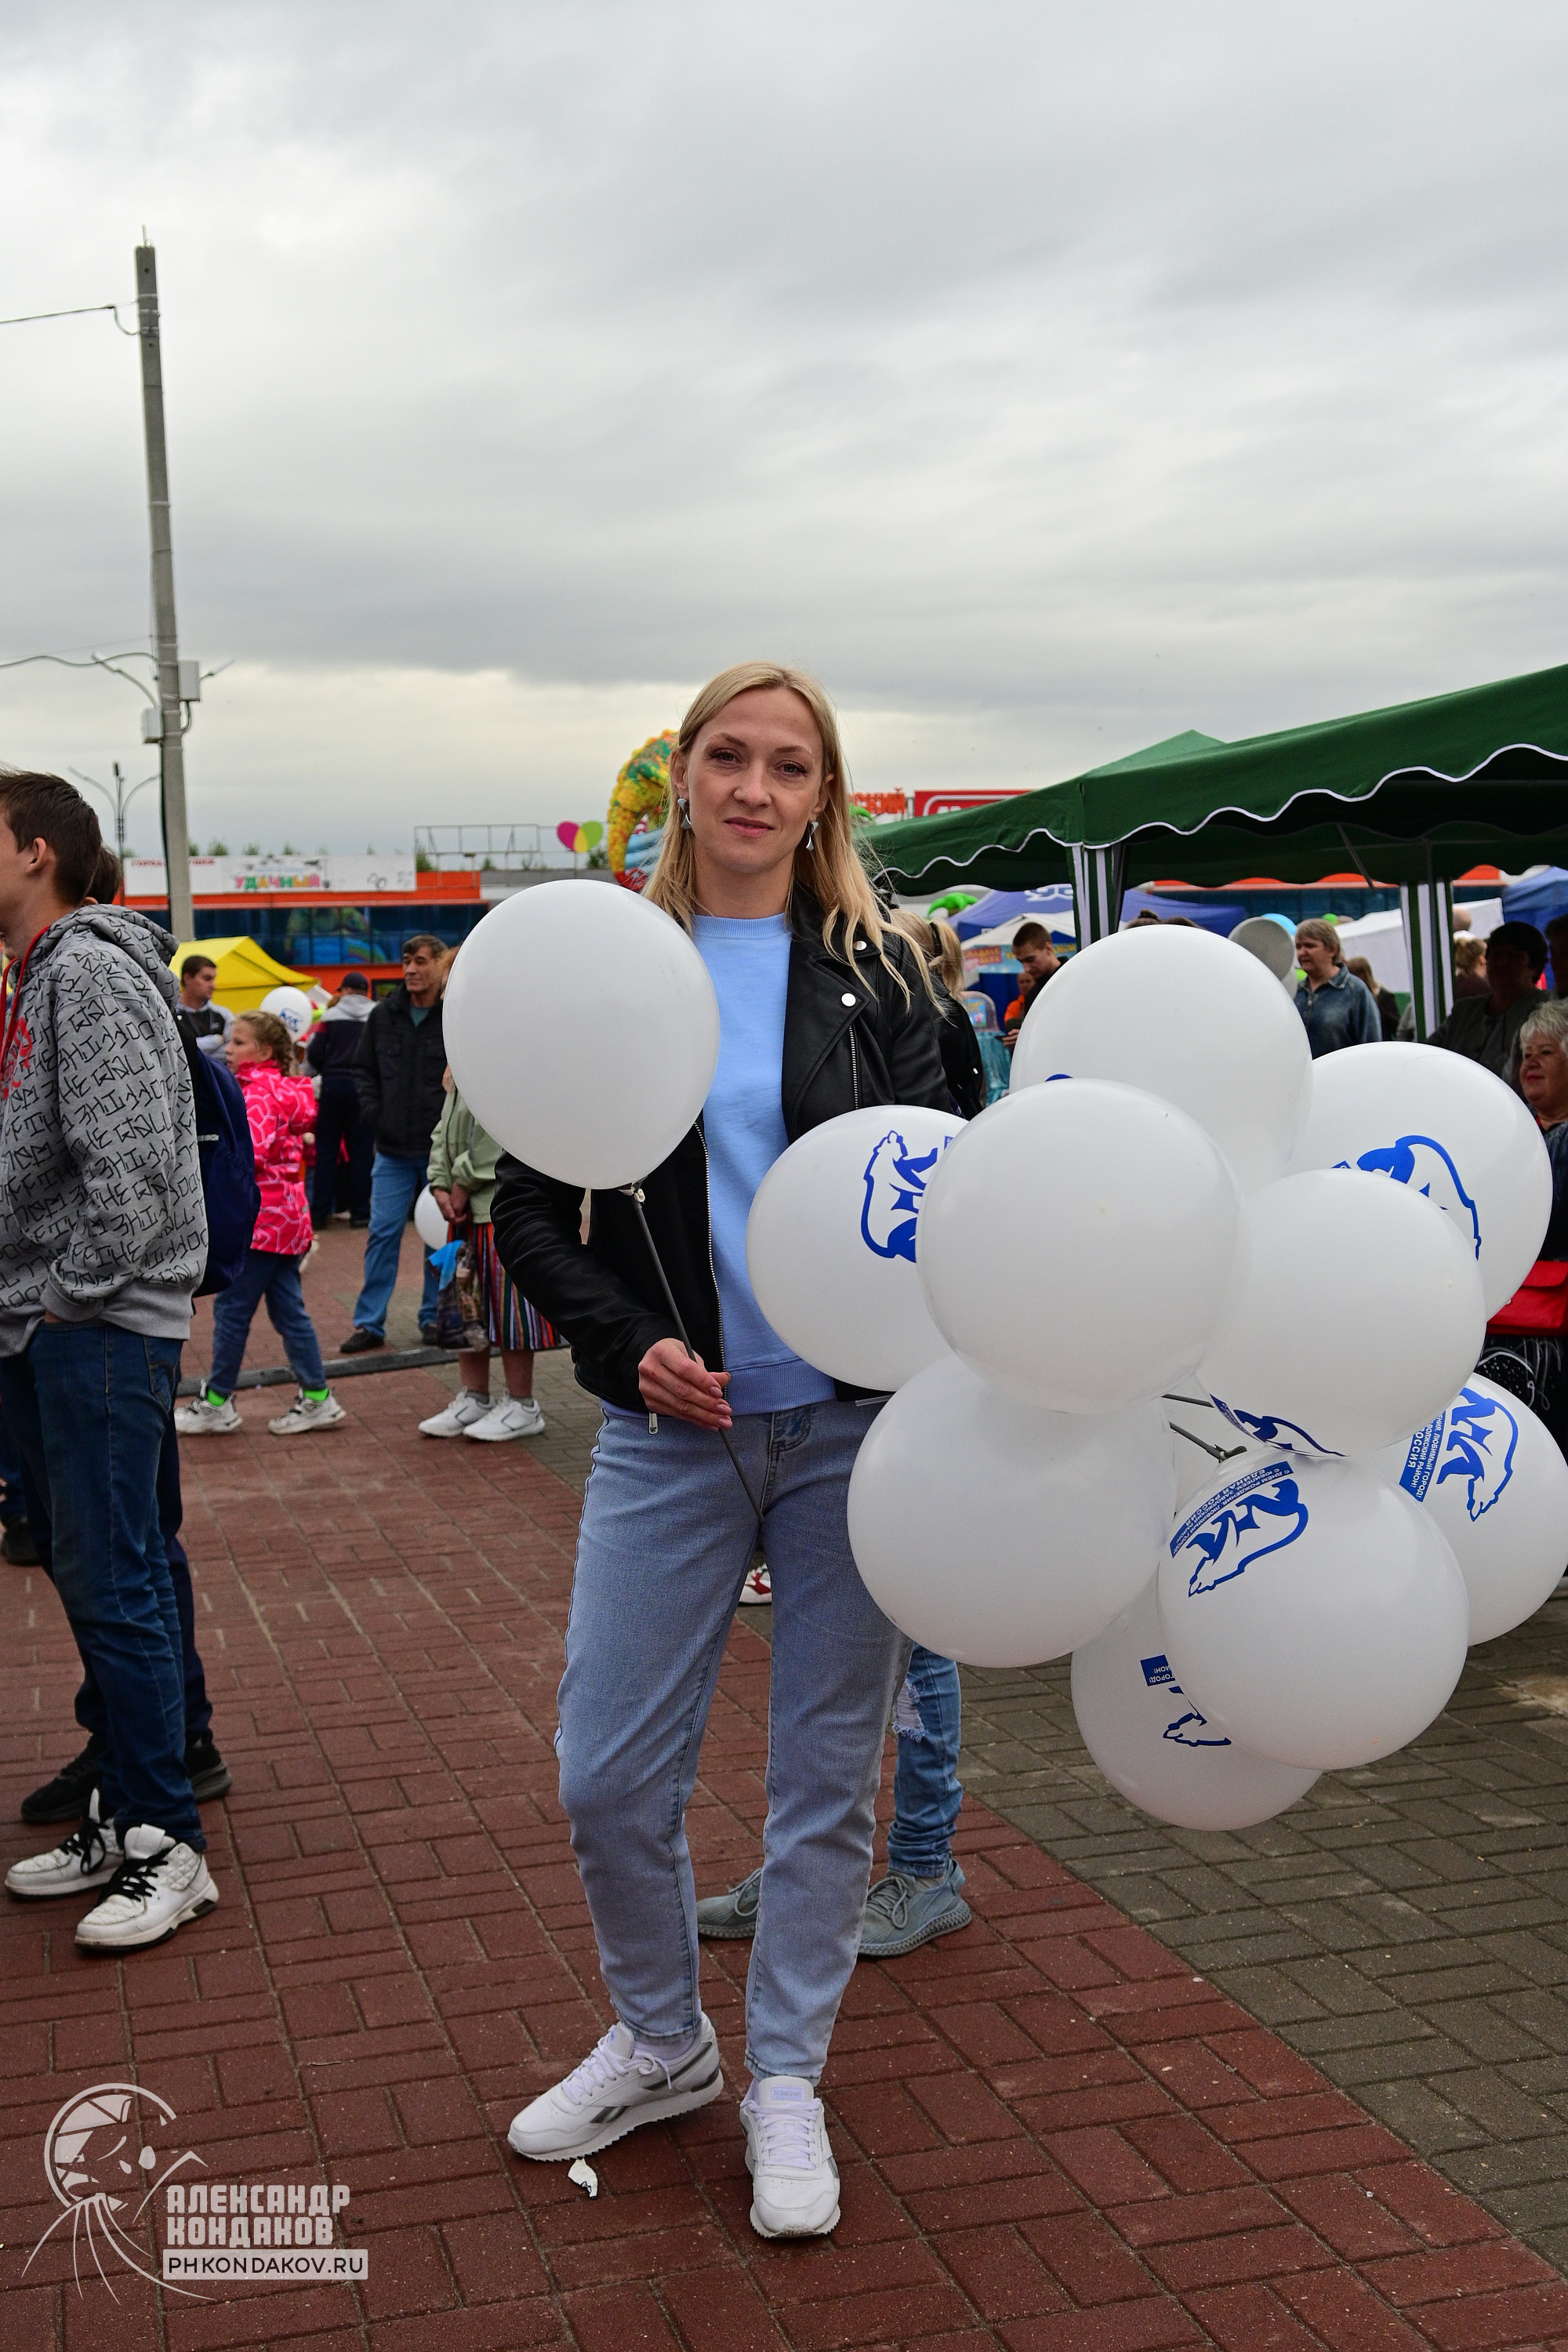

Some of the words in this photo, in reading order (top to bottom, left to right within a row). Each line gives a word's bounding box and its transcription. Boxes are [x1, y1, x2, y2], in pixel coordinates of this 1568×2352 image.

[234, 873, 320, 891] УДАЧНЫЙ
[1420, 1424, 1433, 1461] ВОЛЖСКИЙ
[1425, 1433, 1440, 1470] ЛЮБИМЫЙ
[1222, 1468, 1266, 1494] ЕДИНАЯ
[1410, 1461, 1425, 1488] РАЙОН!
[1415, 1471, 1430, 1498] ГОРОД!
[1185, 1494, 1221, 1526] РОССИЯ
